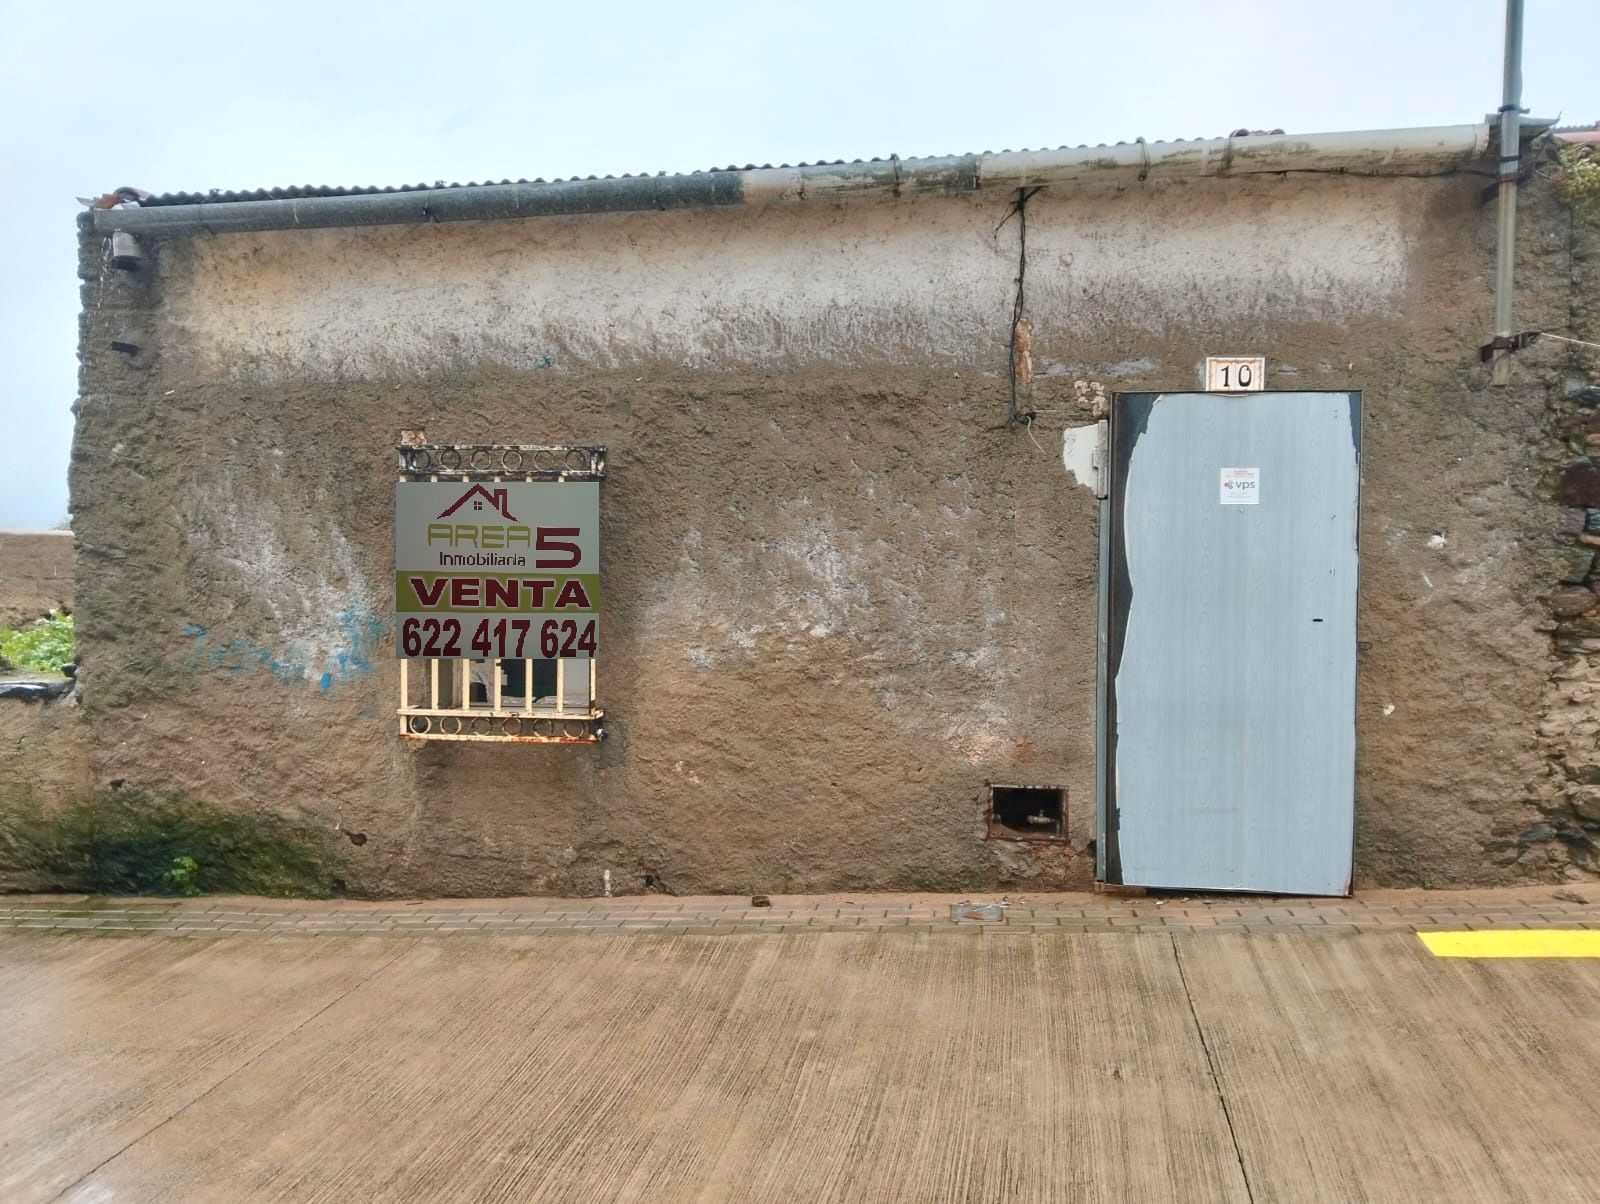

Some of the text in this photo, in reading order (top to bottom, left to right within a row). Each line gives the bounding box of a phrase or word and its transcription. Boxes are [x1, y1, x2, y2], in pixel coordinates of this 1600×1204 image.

[1221, 365, 1252, 387] 10
[1235, 481, 1256, 491] vps
[427, 523, 582, 569] AREA 5
[439, 551, 526, 567] Inmobiliaria
[410, 578, 591, 608] VENTA
[402, 618, 598, 659] 622 417 624
